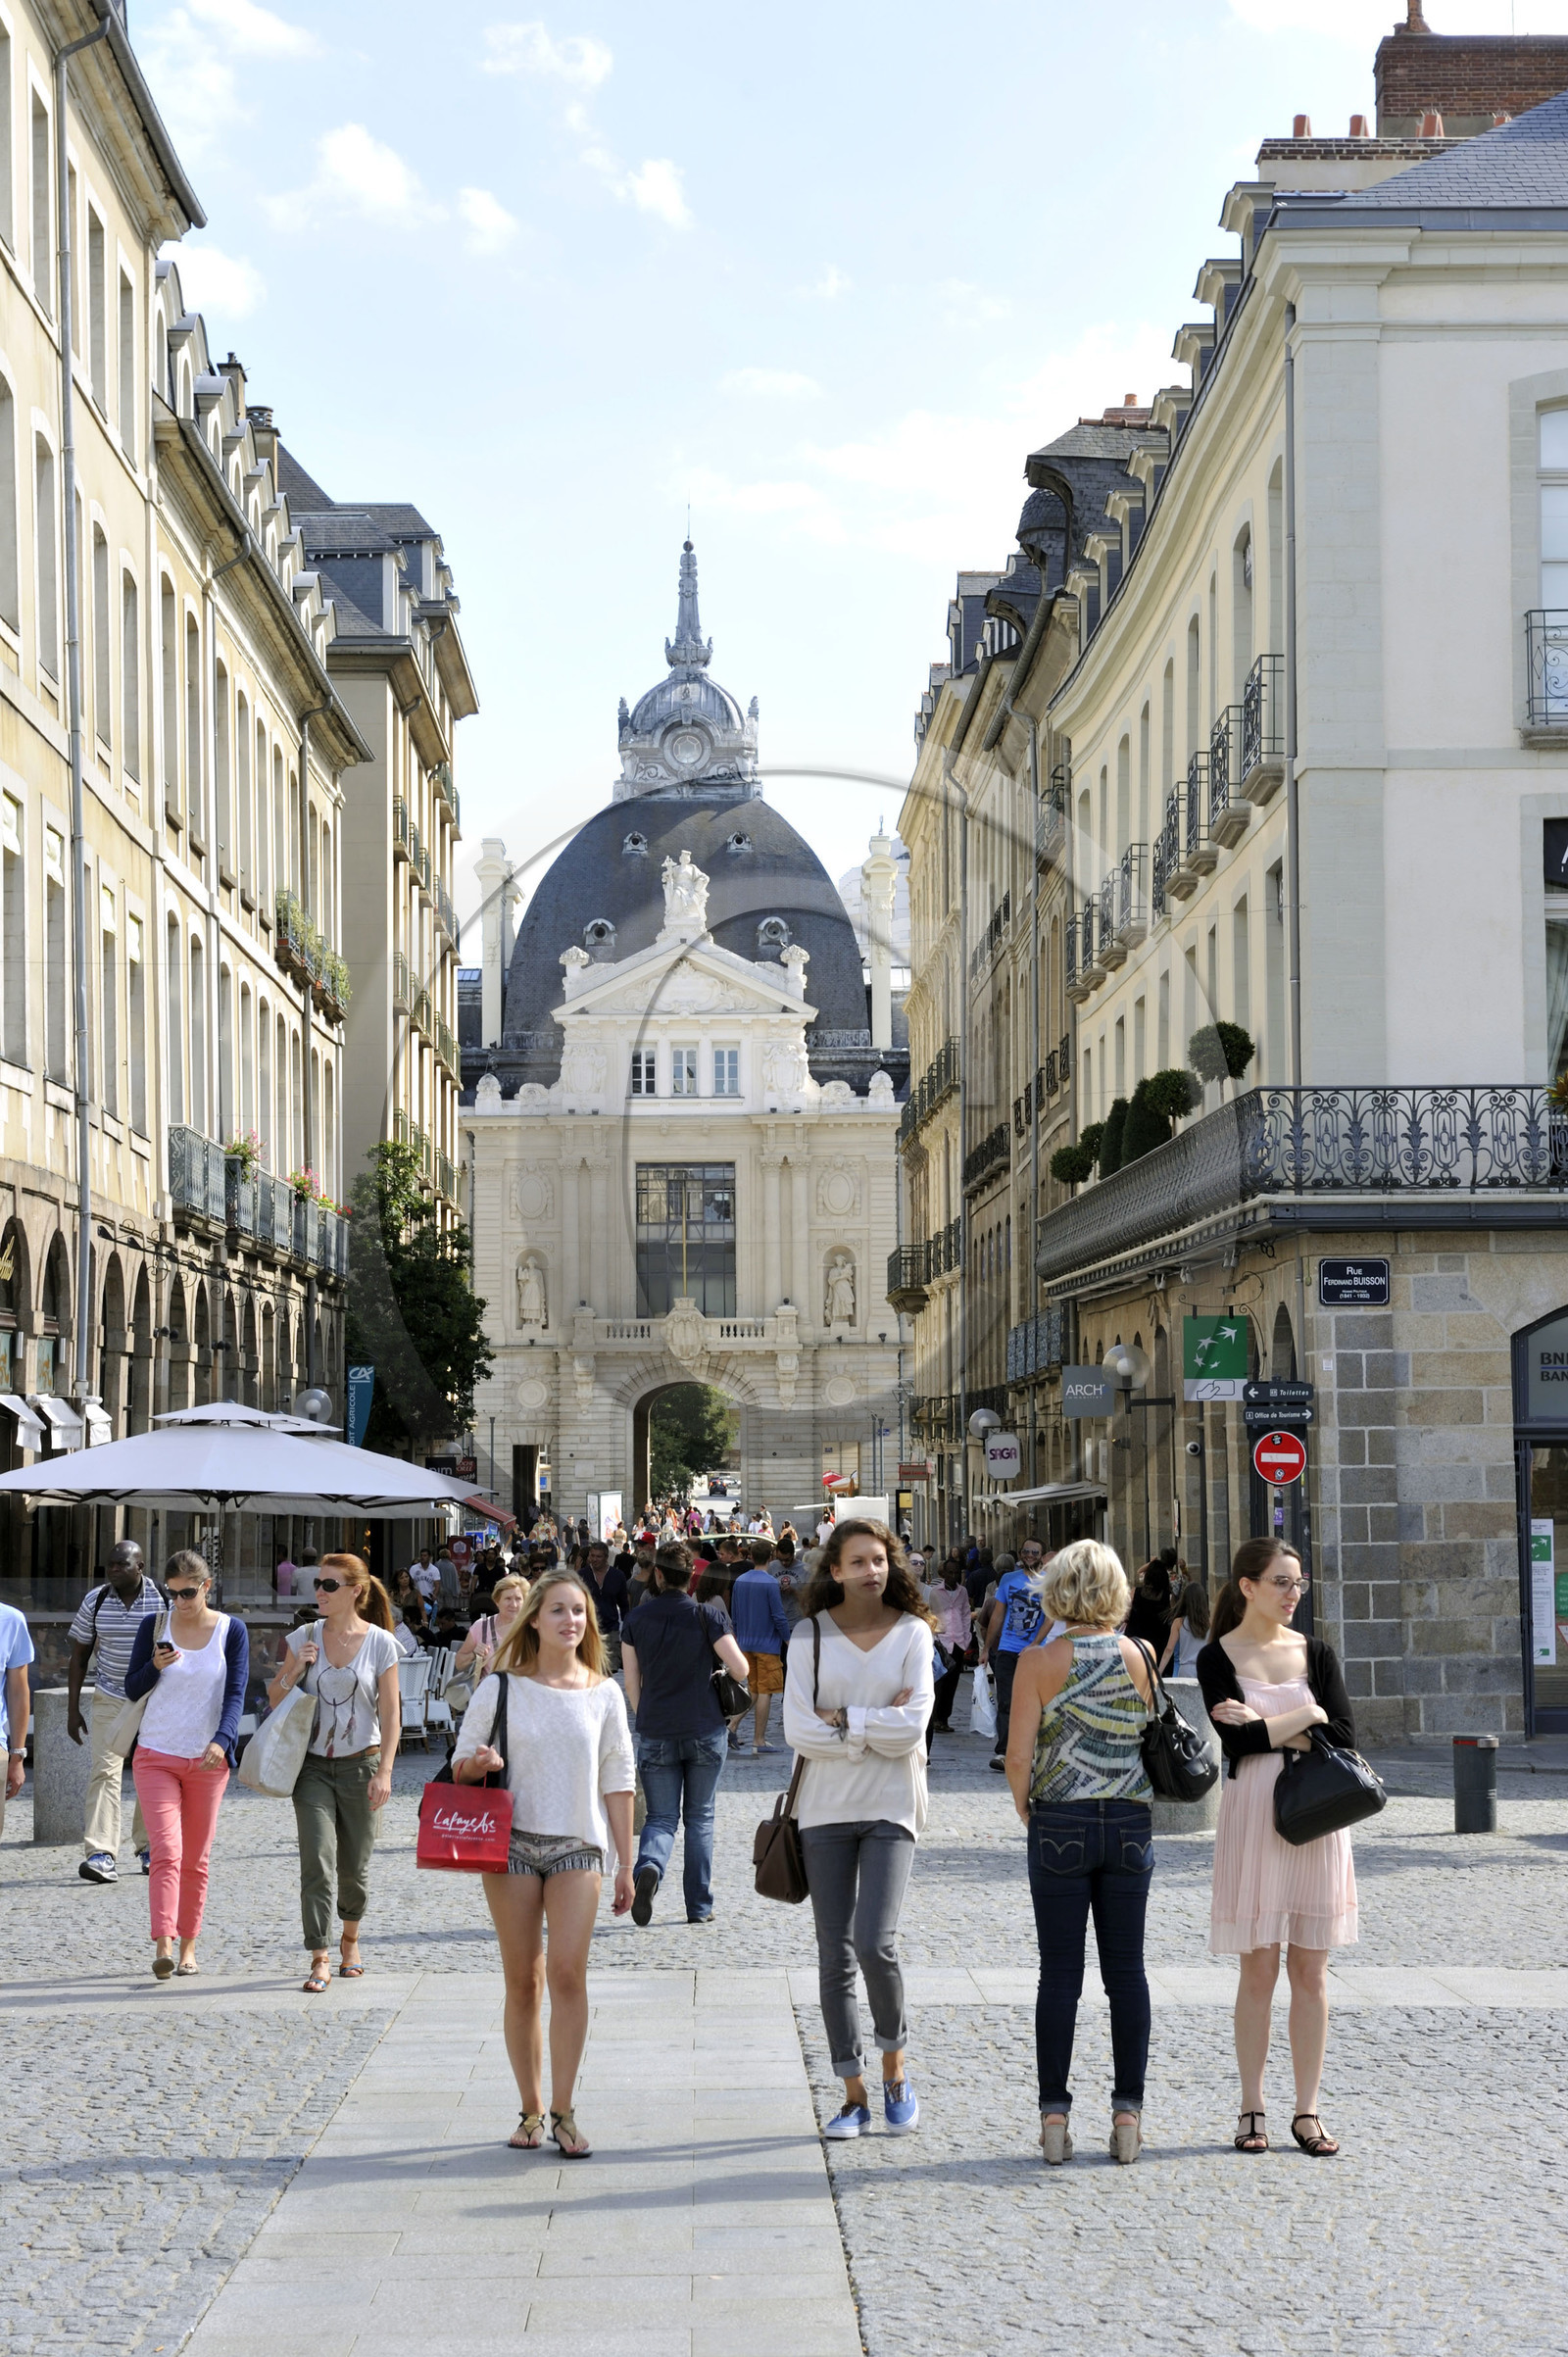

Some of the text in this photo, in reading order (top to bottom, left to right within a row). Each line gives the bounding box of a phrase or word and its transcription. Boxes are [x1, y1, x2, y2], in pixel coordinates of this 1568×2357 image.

[1353, 1277, 1385, 1286] BUISSON
[1541, 1352, 1568, 1365] BN
[989, 1448, 1017, 1460] SAGA
[433, 1808, 496, 1835] Lafayette
